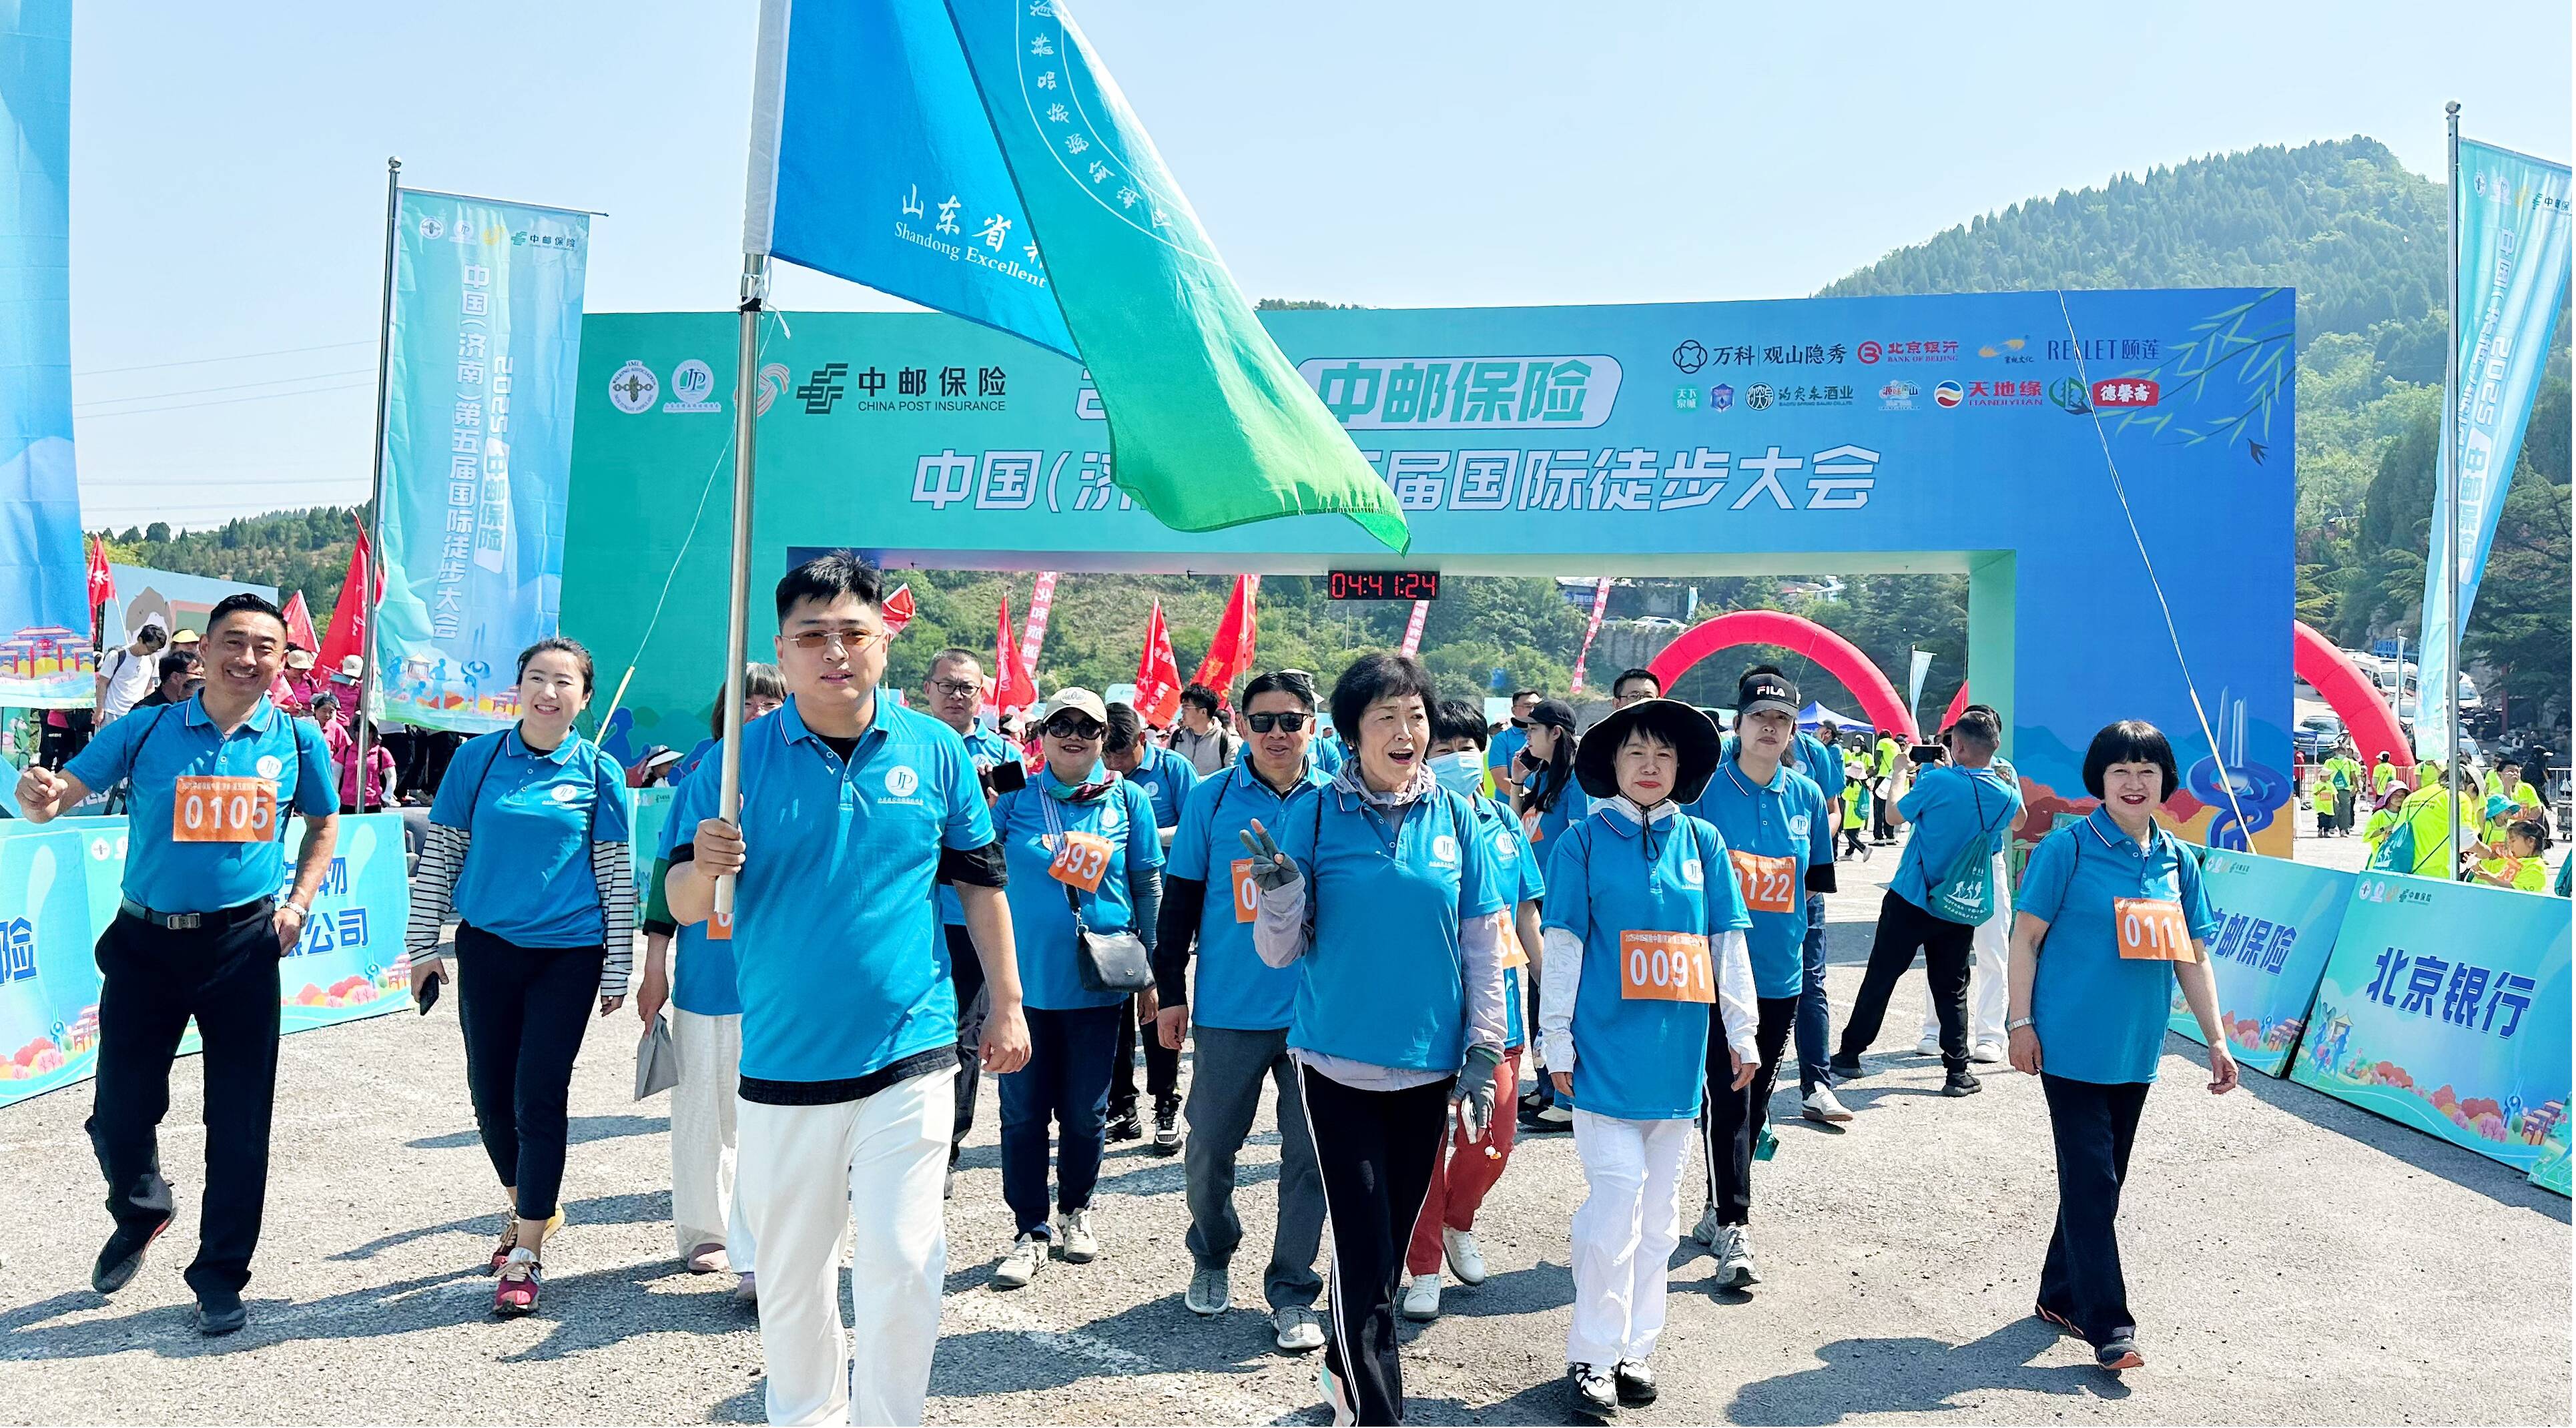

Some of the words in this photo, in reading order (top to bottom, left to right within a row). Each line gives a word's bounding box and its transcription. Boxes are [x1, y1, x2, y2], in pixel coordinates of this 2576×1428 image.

[894, 221, 962, 262] Shandong
[965, 246, 1047, 289] Excellent
[1712, 346, 1756, 366] 万科
[1762, 343, 1848, 366] 观山隐秀
[1887, 341, 1959, 354] 北京银行
[2122, 339, 2160, 361] 颐莲
[858, 366, 1006, 397] 中邮保险
[1317, 360, 1592, 423] 中邮保险
[1968, 380, 2042, 397] 天地缘
[2475, 336, 2513, 425] 2025
[858, 401, 896, 411] CHINA
[899, 401, 932, 411] POST
[935, 401, 1006, 411] INSURANCE
[476, 453, 507, 553] 中邮保险
[1756, 685, 1786, 697] FILA
[891, 771, 914, 790] JP
[185, 795, 268, 829] 0105
[288, 908, 368, 958] 公司
[2124, 914, 2188, 951] 0111
[1630, 948, 1705, 990] 0091
[2366, 947, 2537, 1039] 北京银行
